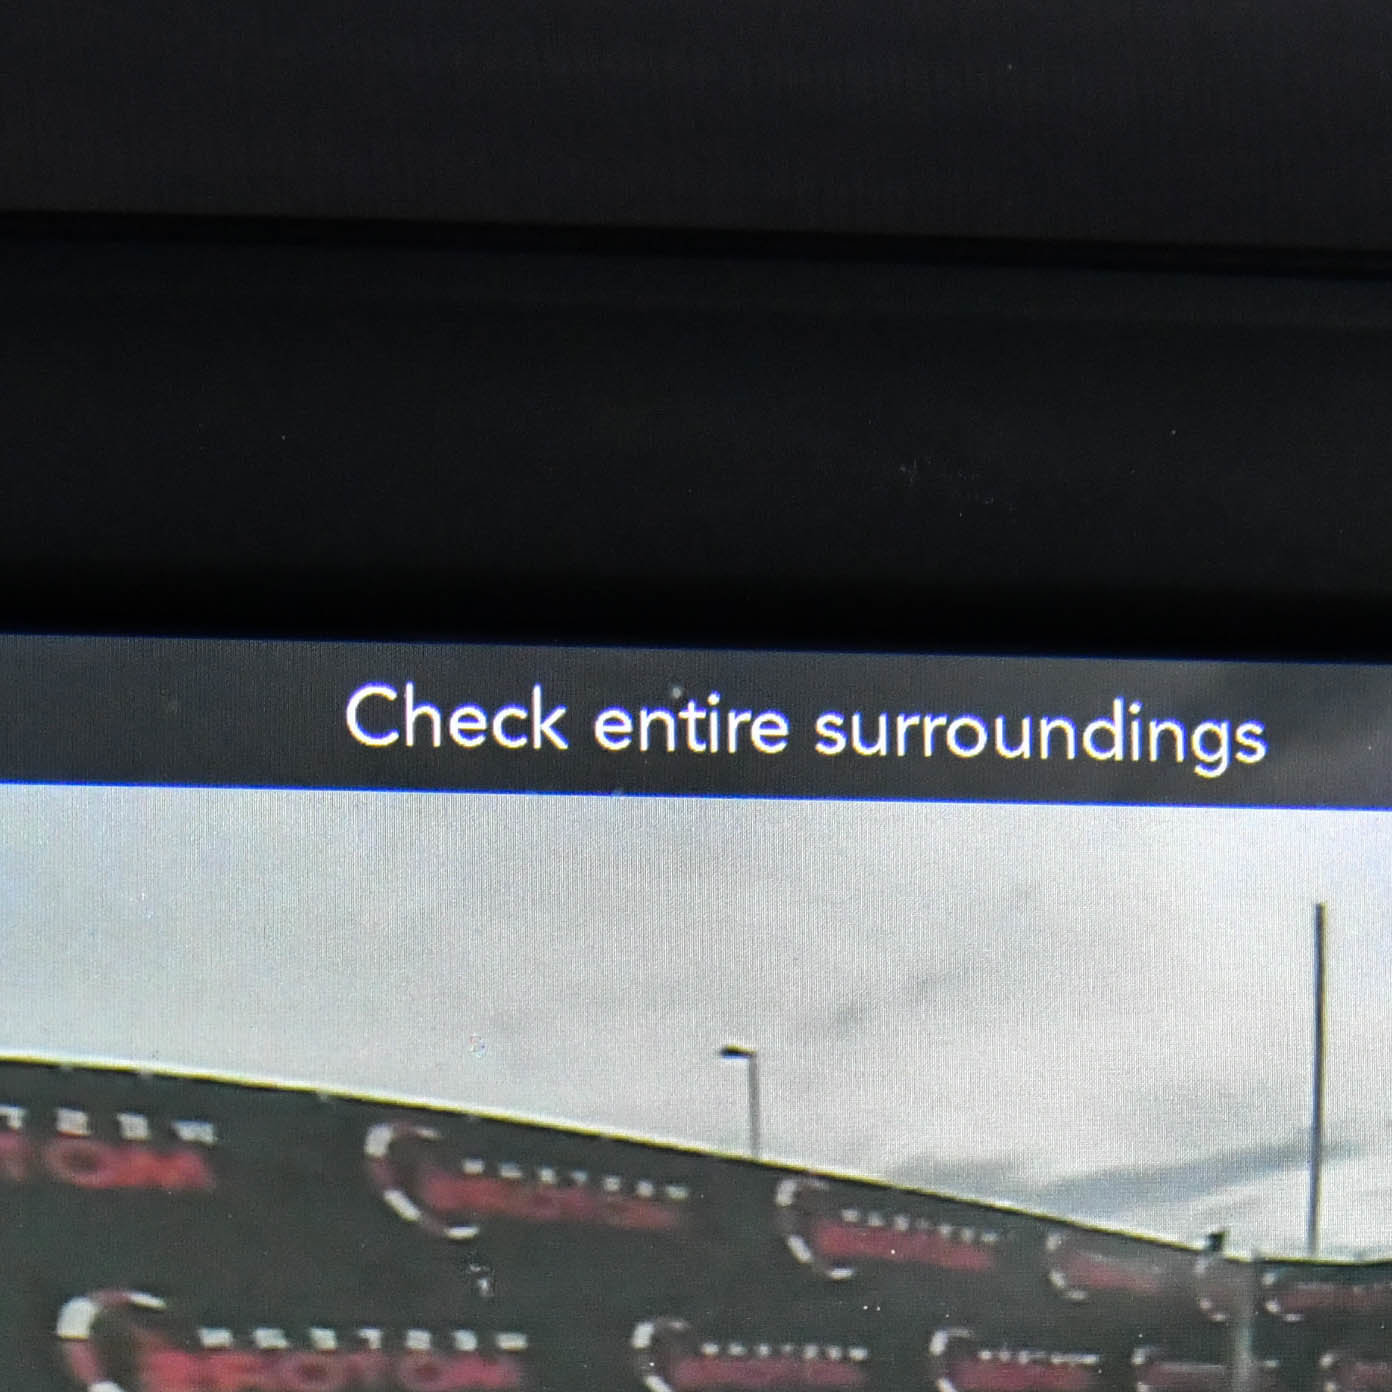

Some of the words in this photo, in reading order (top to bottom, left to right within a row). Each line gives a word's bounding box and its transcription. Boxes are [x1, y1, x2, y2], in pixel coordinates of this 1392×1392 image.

[343, 681, 570, 751] Check
[593, 691, 791, 755] entire
[814, 696, 1269, 780] surroundings
